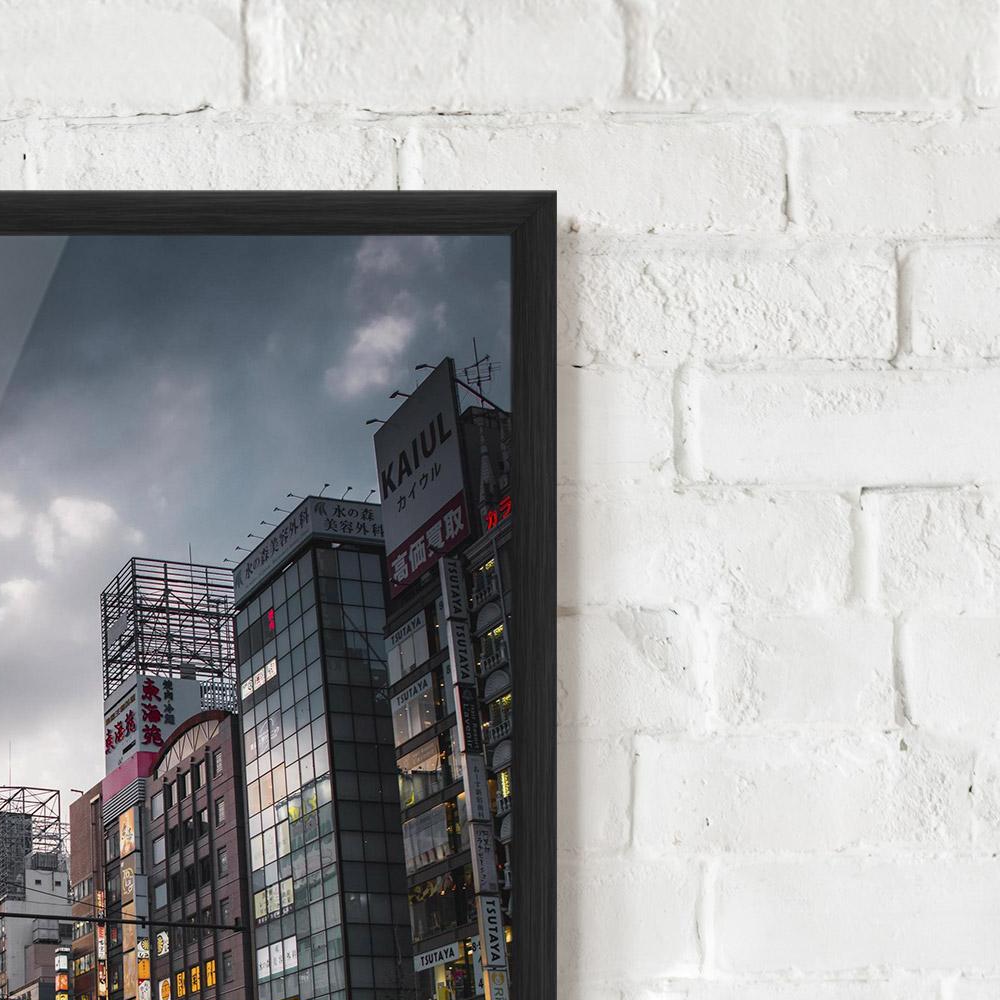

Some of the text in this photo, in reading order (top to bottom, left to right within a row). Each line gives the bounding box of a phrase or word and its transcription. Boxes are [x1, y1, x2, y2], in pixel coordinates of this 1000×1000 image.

[382, 412, 452, 500] KAIUL
[397, 463, 442, 512] カイウル
[326, 519, 384, 537] 美容外科
[333, 505, 375, 521] 水の森
[391, 505, 464, 587] 高価買取
[448, 562, 463, 615] TSUTAYA
[392, 617, 422, 646] TSUTAYA
[456, 625, 470, 682] TSUTAYA
[396, 680, 429, 706] TSUTAYA
[485, 900, 501, 962] TSUTAYA
[421, 947, 455, 967] TSUTAYA
